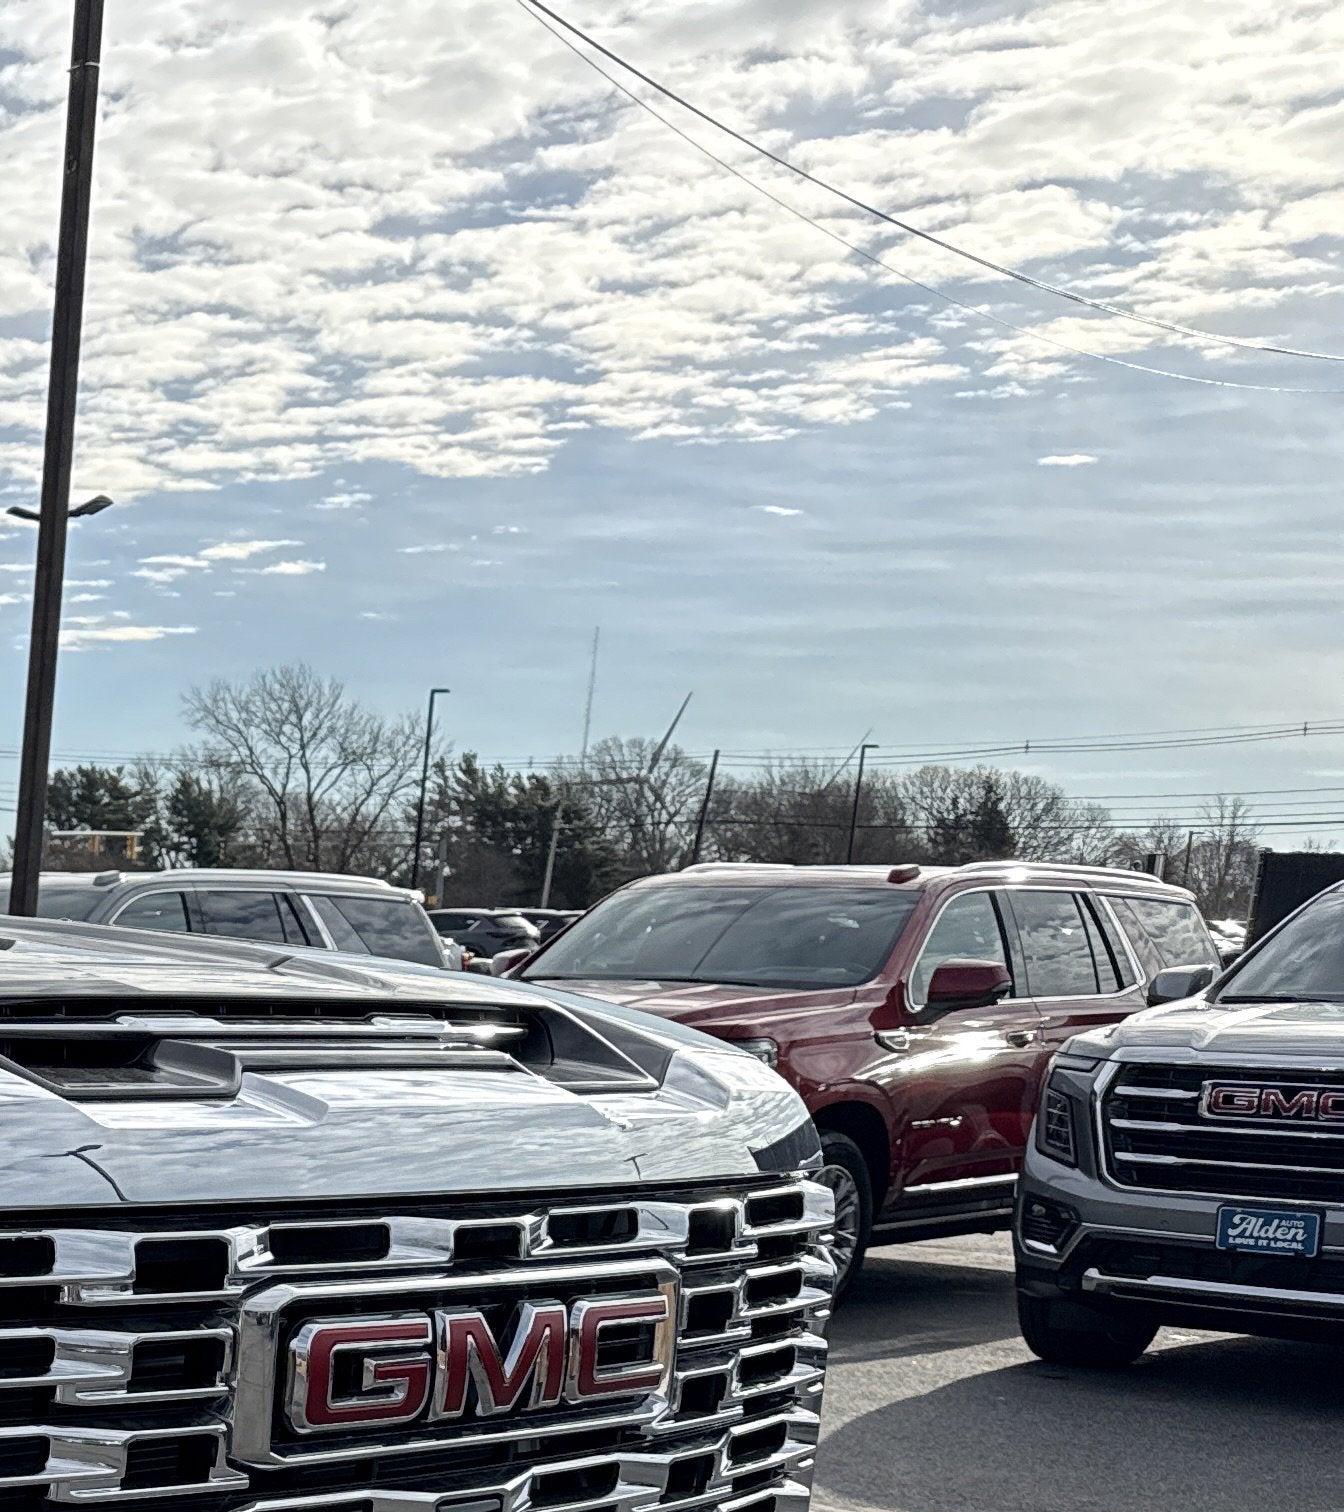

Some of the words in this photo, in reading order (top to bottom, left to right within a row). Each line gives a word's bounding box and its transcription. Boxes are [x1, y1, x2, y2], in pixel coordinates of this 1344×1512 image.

[1227, 1213, 1308, 1241] Alden
[1279, 1219, 1305, 1228] AUTO
[1228, 1236, 1256, 1246] LOVE
[1257, 1239, 1269, 1247] IT
[1270, 1240, 1305, 1250] LOCAL
[289, 1290, 669, 1434] GMC
